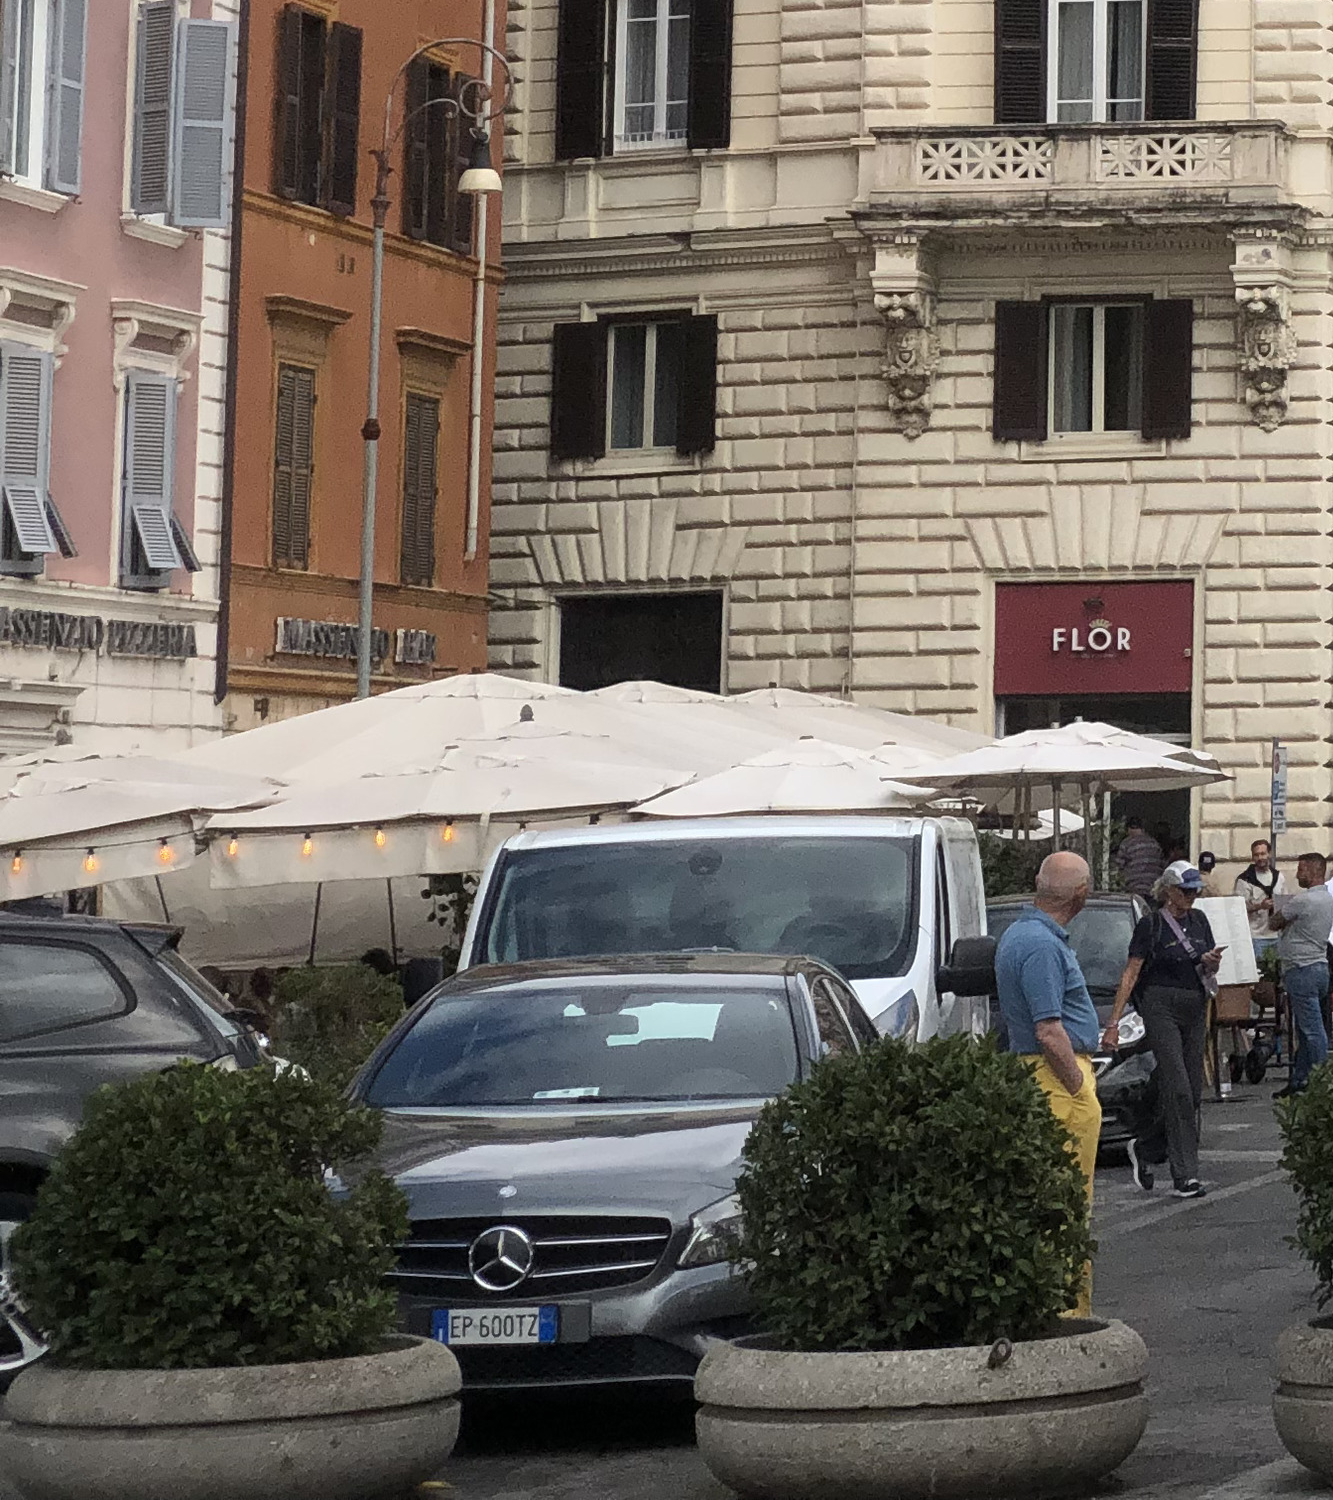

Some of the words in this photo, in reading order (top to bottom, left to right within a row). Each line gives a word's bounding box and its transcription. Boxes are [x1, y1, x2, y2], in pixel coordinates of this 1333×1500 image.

[276, 617, 389, 660] MASSENIO
[1052, 627, 1131, 651] FLOR
[450, 1316, 473, 1338] EP
[479, 1314, 538, 1338] 600TZ
